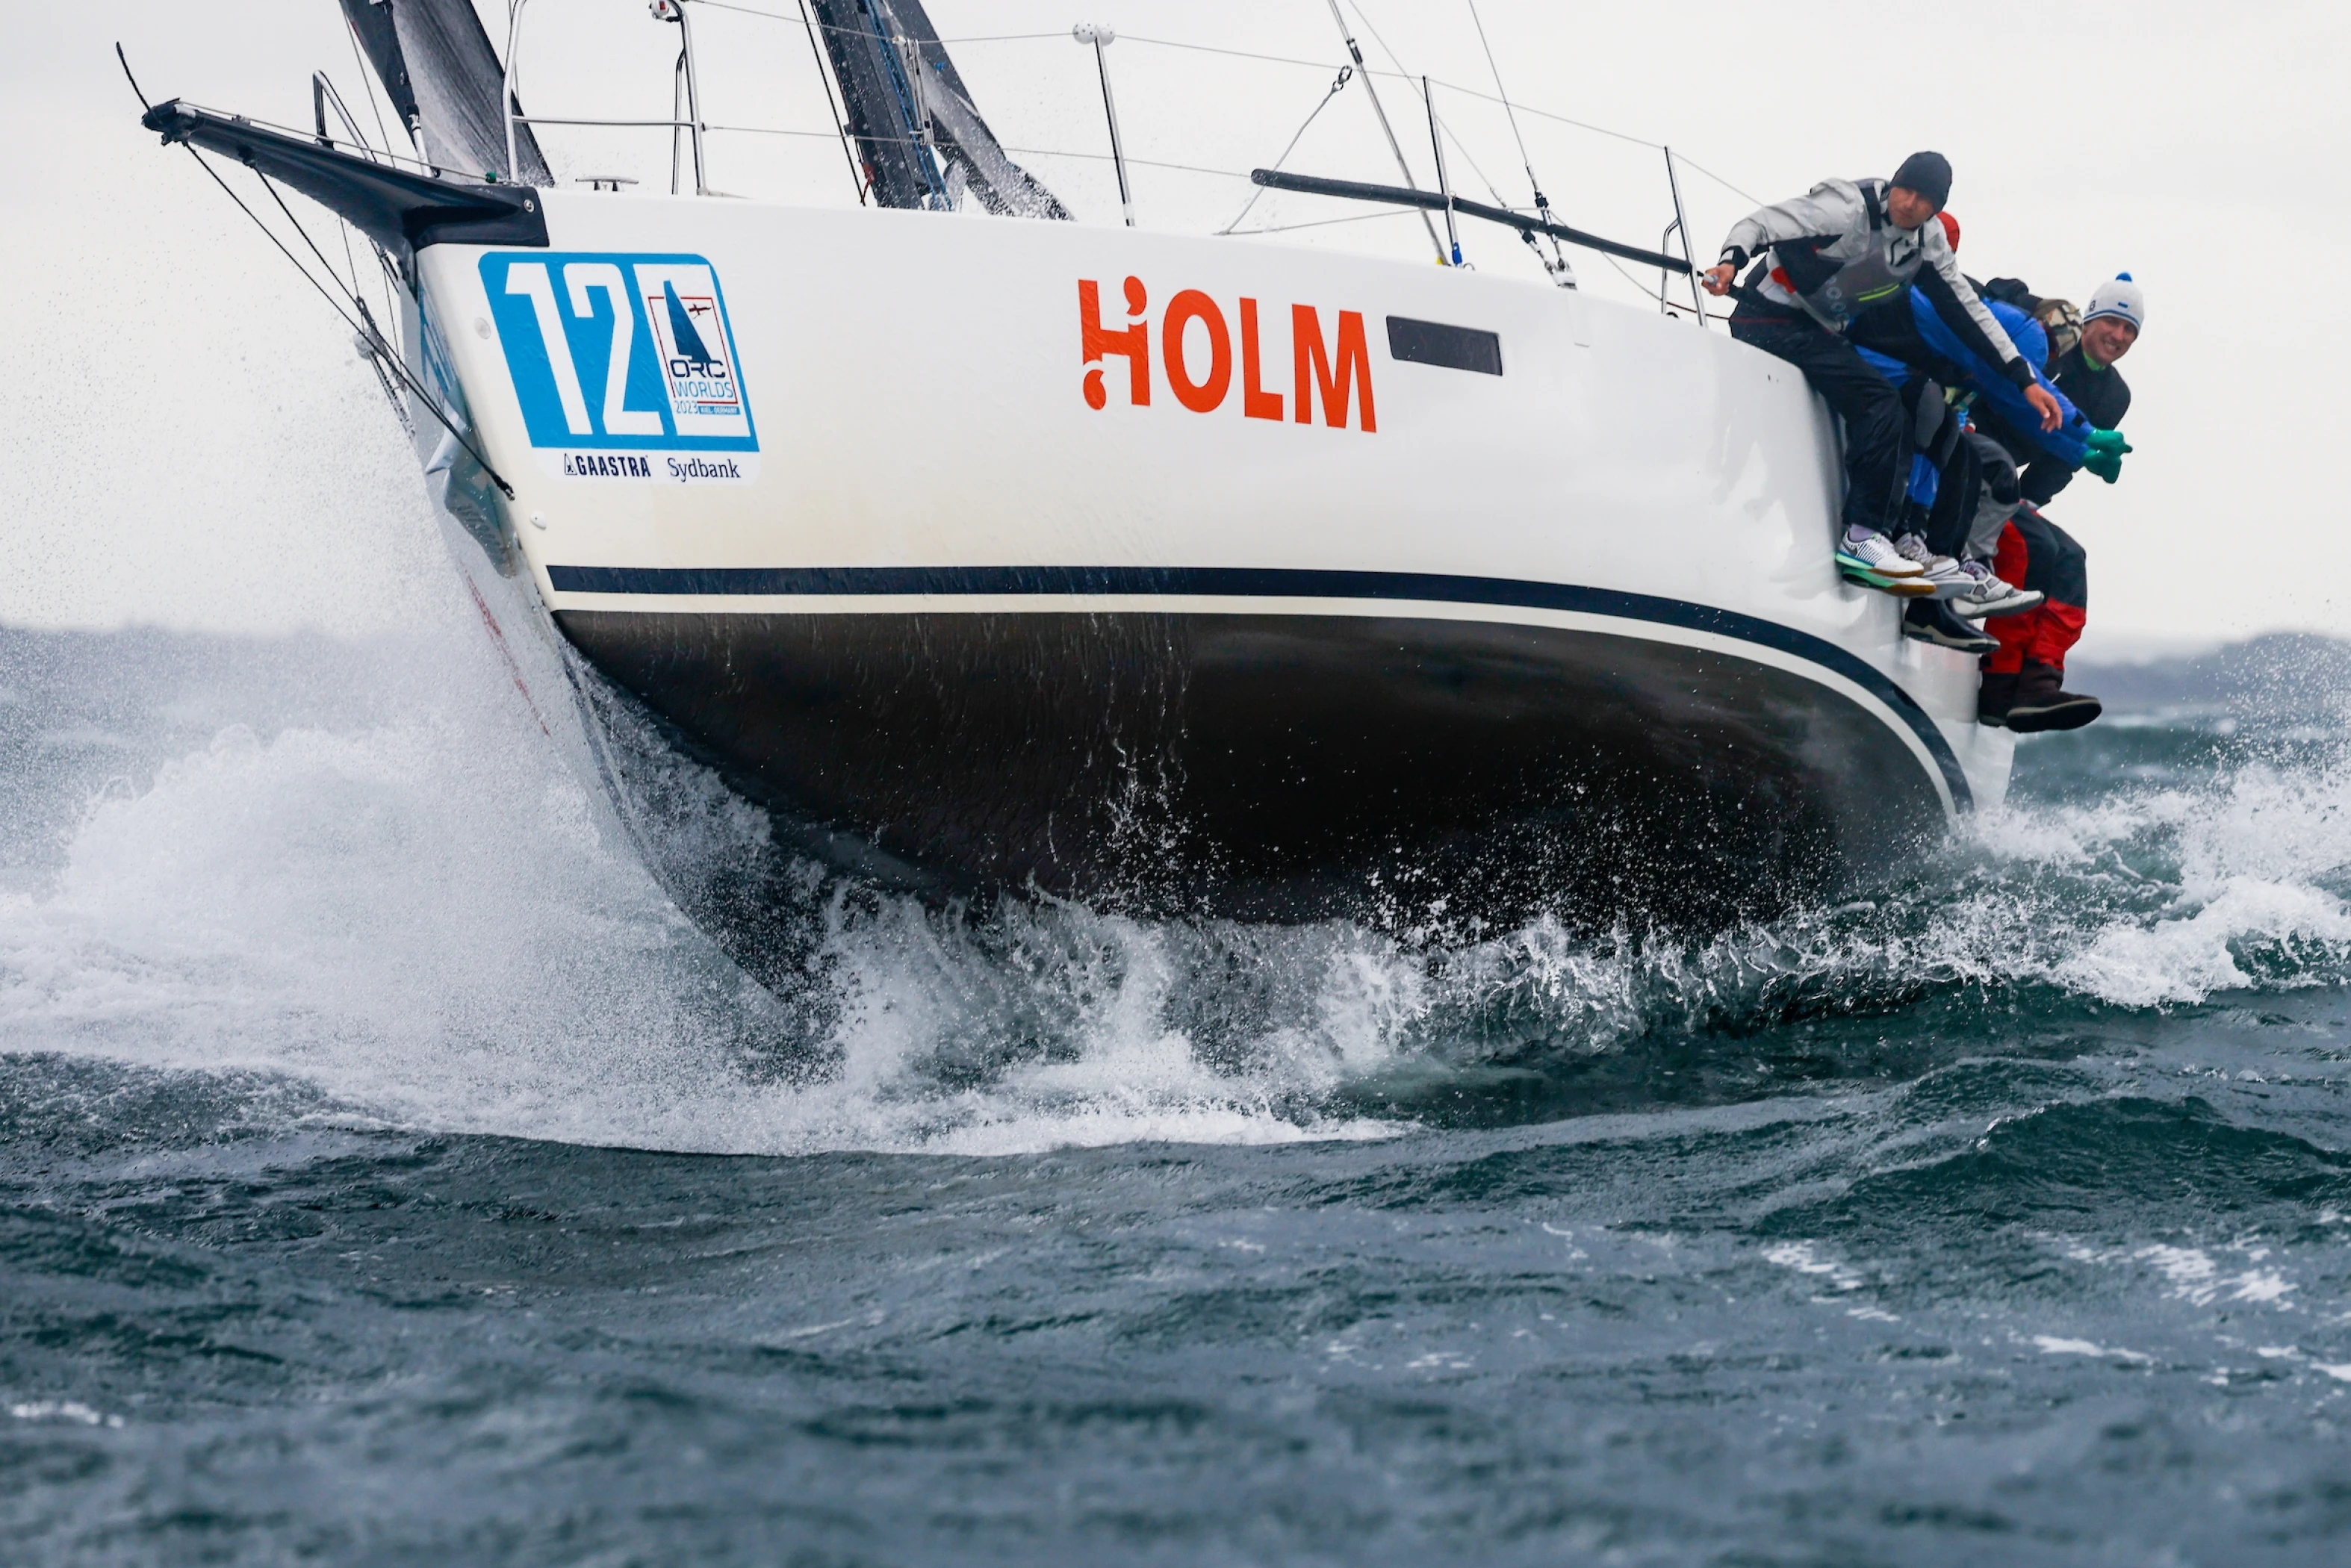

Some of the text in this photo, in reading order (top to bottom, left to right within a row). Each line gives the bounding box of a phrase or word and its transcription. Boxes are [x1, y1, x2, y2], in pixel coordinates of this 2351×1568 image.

[505, 262, 665, 436] 12
[1078, 276, 1377, 434] HOLM
[670, 359, 726, 379] ORC
[674, 381, 734, 398] WORLDS
[674, 400, 698, 414] 2023
[575, 455, 651, 477] GAASTRA
[667, 458, 742, 483] Sydbank
